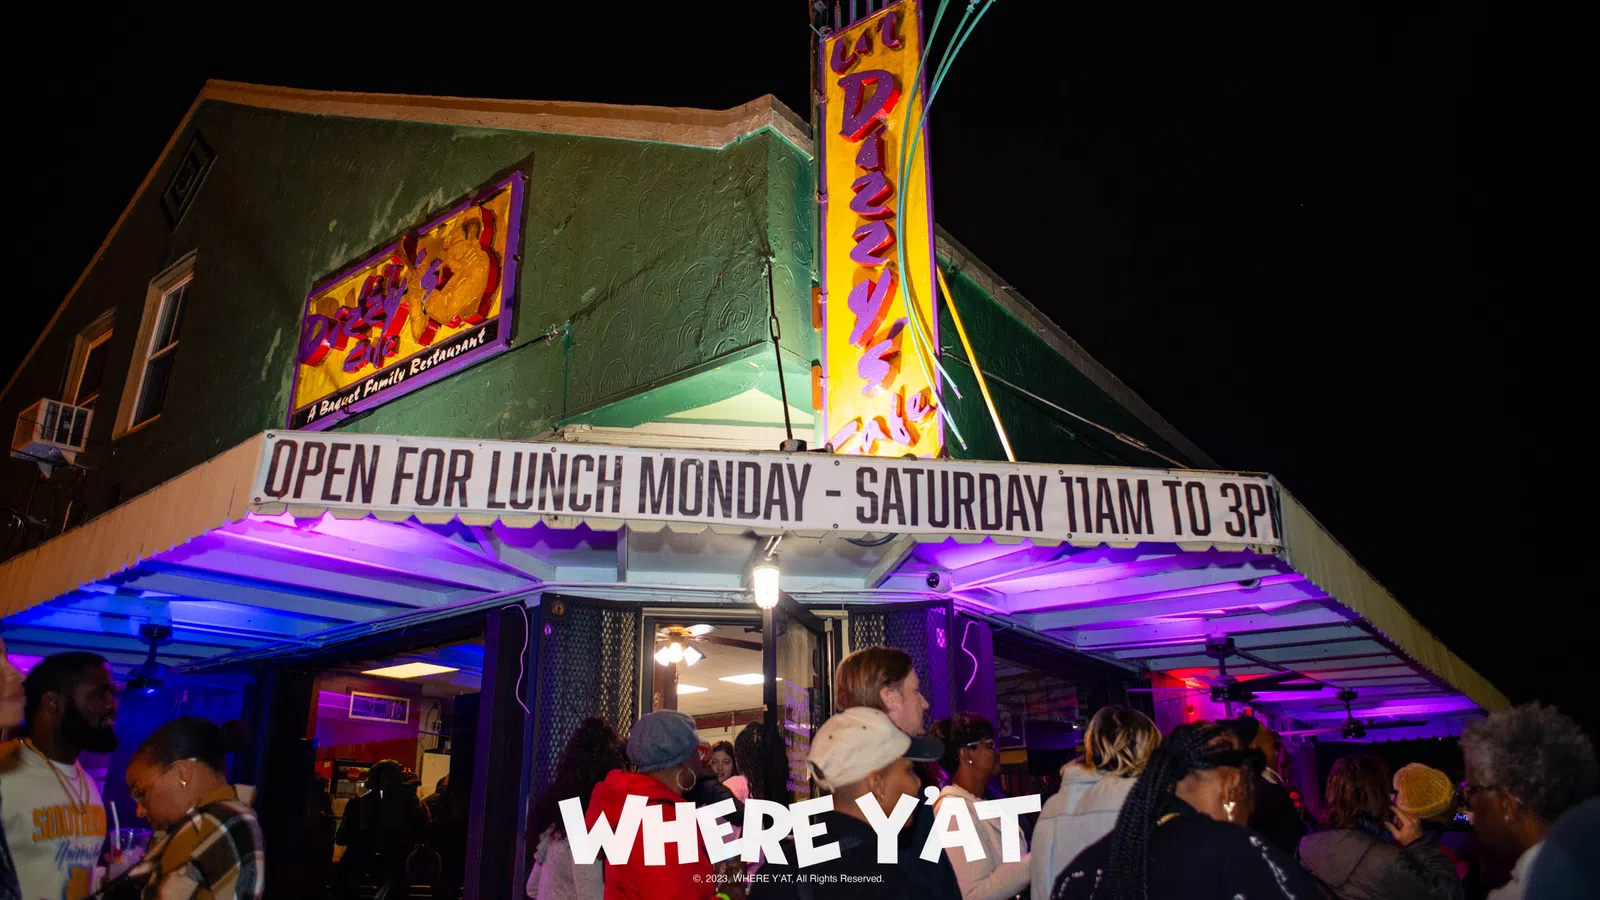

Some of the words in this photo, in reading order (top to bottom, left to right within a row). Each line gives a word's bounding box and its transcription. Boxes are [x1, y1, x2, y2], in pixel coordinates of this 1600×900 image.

[307, 405, 317, 423] A
[319, 388, 361, 416] Baquet
[363, 368, 407, 398] Family
[409, 326, 486, 375] Restaurant
[263, 439, 381, 503] OPEN
[390, 446, 474, 507] FOR
[486, 450, 624, 513] LUNCH
[638, 456, 812, 522] MONDAY
[856, 466, 1048, 532] SATURDAY
[1060, 476, 1154, 535] 11AM
[1162, 480, 1211, 537] TO
